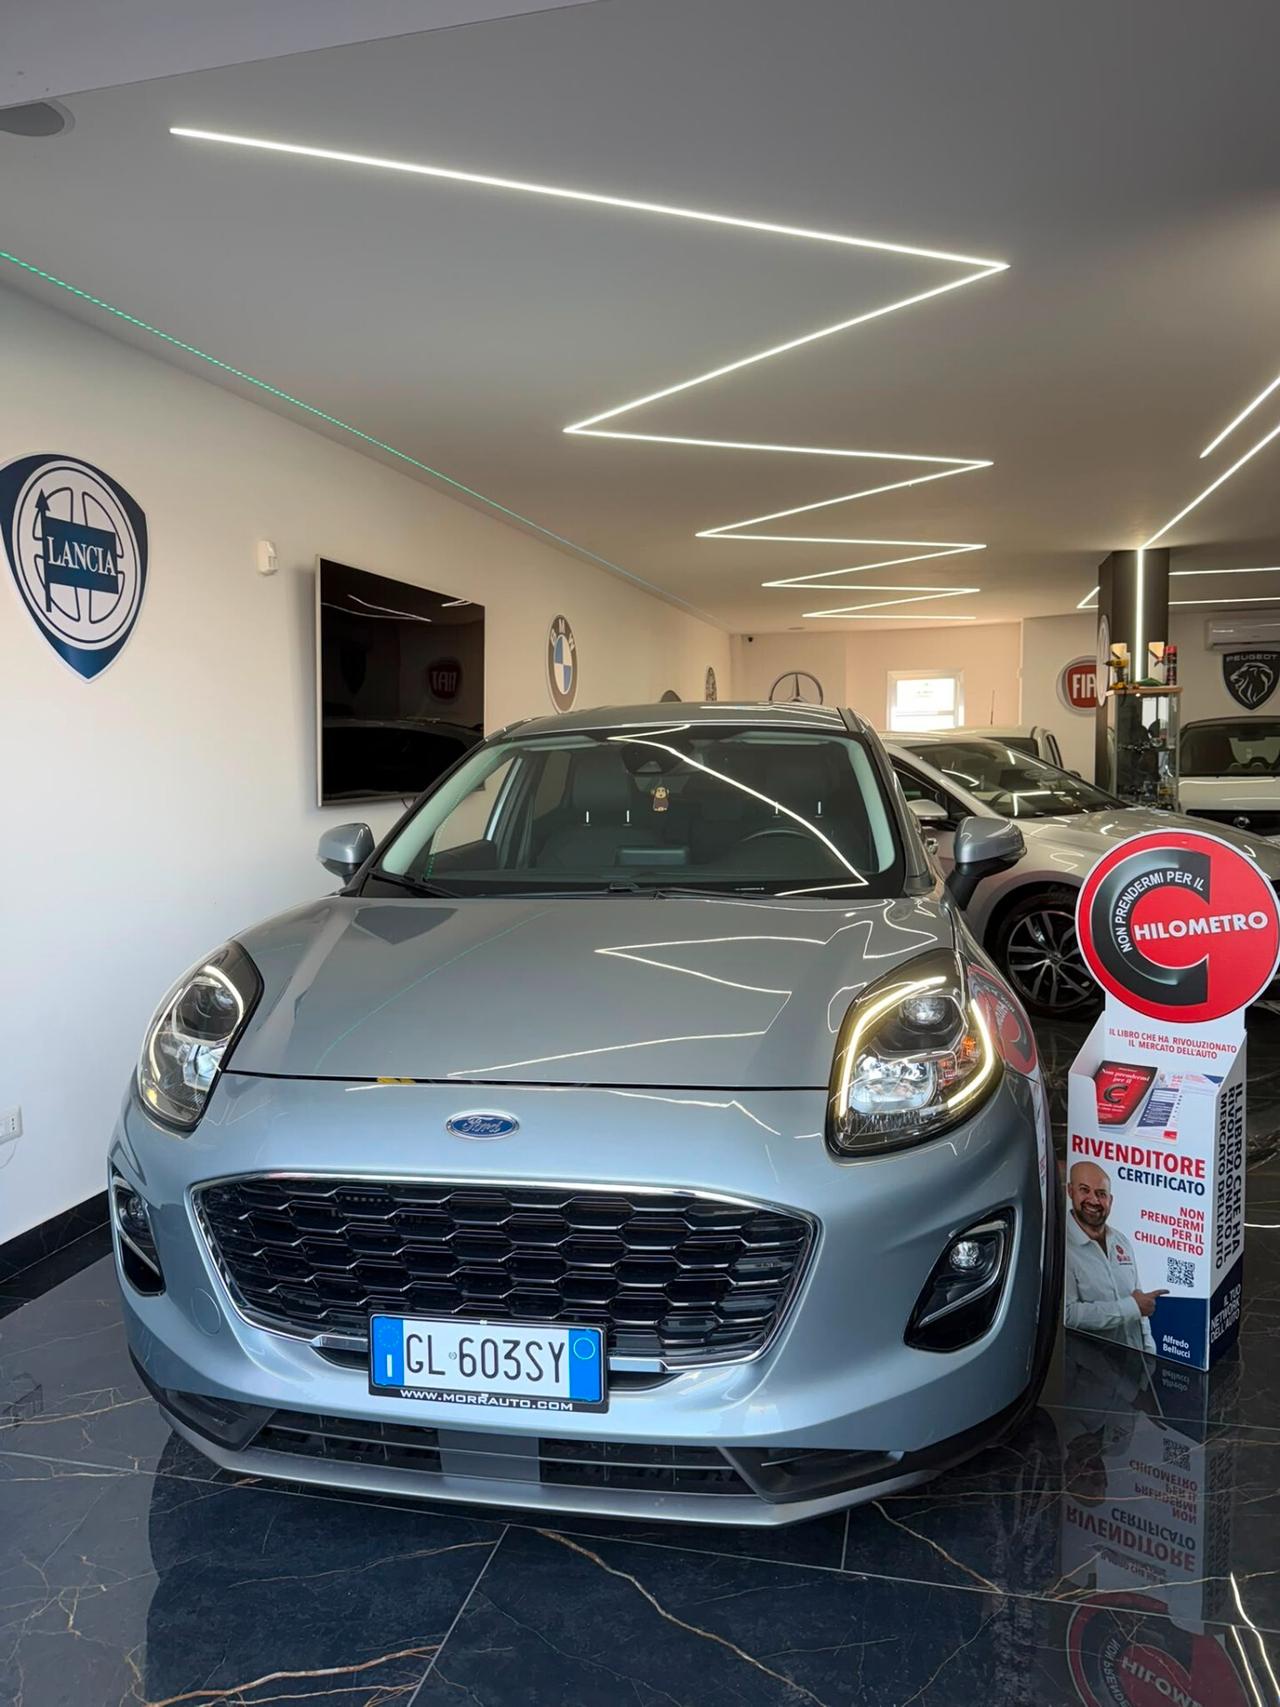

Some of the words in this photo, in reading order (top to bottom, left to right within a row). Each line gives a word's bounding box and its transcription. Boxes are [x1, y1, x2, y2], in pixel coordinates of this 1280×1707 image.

[46, 535, 117, 577] LANCIA
[549, 618, 577, 653] BMW
[1226, 653, 1278, 662] PEUGEOT
[1166, 871, 1193, 885] PER
[1193, 877, 1205, 891] IL
[1114, 871, 1164, 926] PRENDERMI
[1113, 926, 1132, 953] NON
[1109, 1028, 1116, 1036] IL
[1117, 1029, 1140, 1040] LIBRO
[1141, 1032, 1157, 1042] CHE
[1157, 1034, 1169, 1043] HA
[1172, 1037, 1238, 1053] RIVOLUZIONATO
[1128, 1040, 1136, 1048] IL
[1138, 1041, 1176, 1054] MERCATO
[1176, 1045, 1217, 1059] DELL'AUTO
[1231, 1082, 1243, 1105] IL
[462, 1116, 503, 1133] Ford
[1217, 1092, 1227, 1176] MERCATO
[1232, 1105, 1243, 1170] LIBRO
[1072, 1135, 1206, 1179] RIVENDITORE
[1224, 1086, 1236, 1238] RIVOLUZIONATO
[1118, 1167, 1205, 1197] CERTIFICATO
[1231, 1174, 1243, 1217] CHE
[1140, 1209, 1205, 1233] PRENDERMI
[1179, 1207, 1205, 1221] NON
[1215, 1178, 1226, 1269] DELL'AUTO
[1134, 1230, 1204, 1256] CHILOMETRO
[1171, 1227, 1193, 1242] PER
[1194, 1231, 1205, 1244] IL
[1230, 1223, 1242, 1256] HA
[1223, 1241, 1233, 1264] IL
[1229, 1283, 1242, 1301] TUO
[1210, 1300, 1241, 1332] NETWORK
[1210, 1312, 1241, 1344] DELL'AUTO
[1162, 1334, 1190, 1349] Alfredo
[1162, 1343, 1191, 1359] Bellucci
[405, 1333, 446, 1376] GL
[458, 1337, 565, 1384] 603SY
